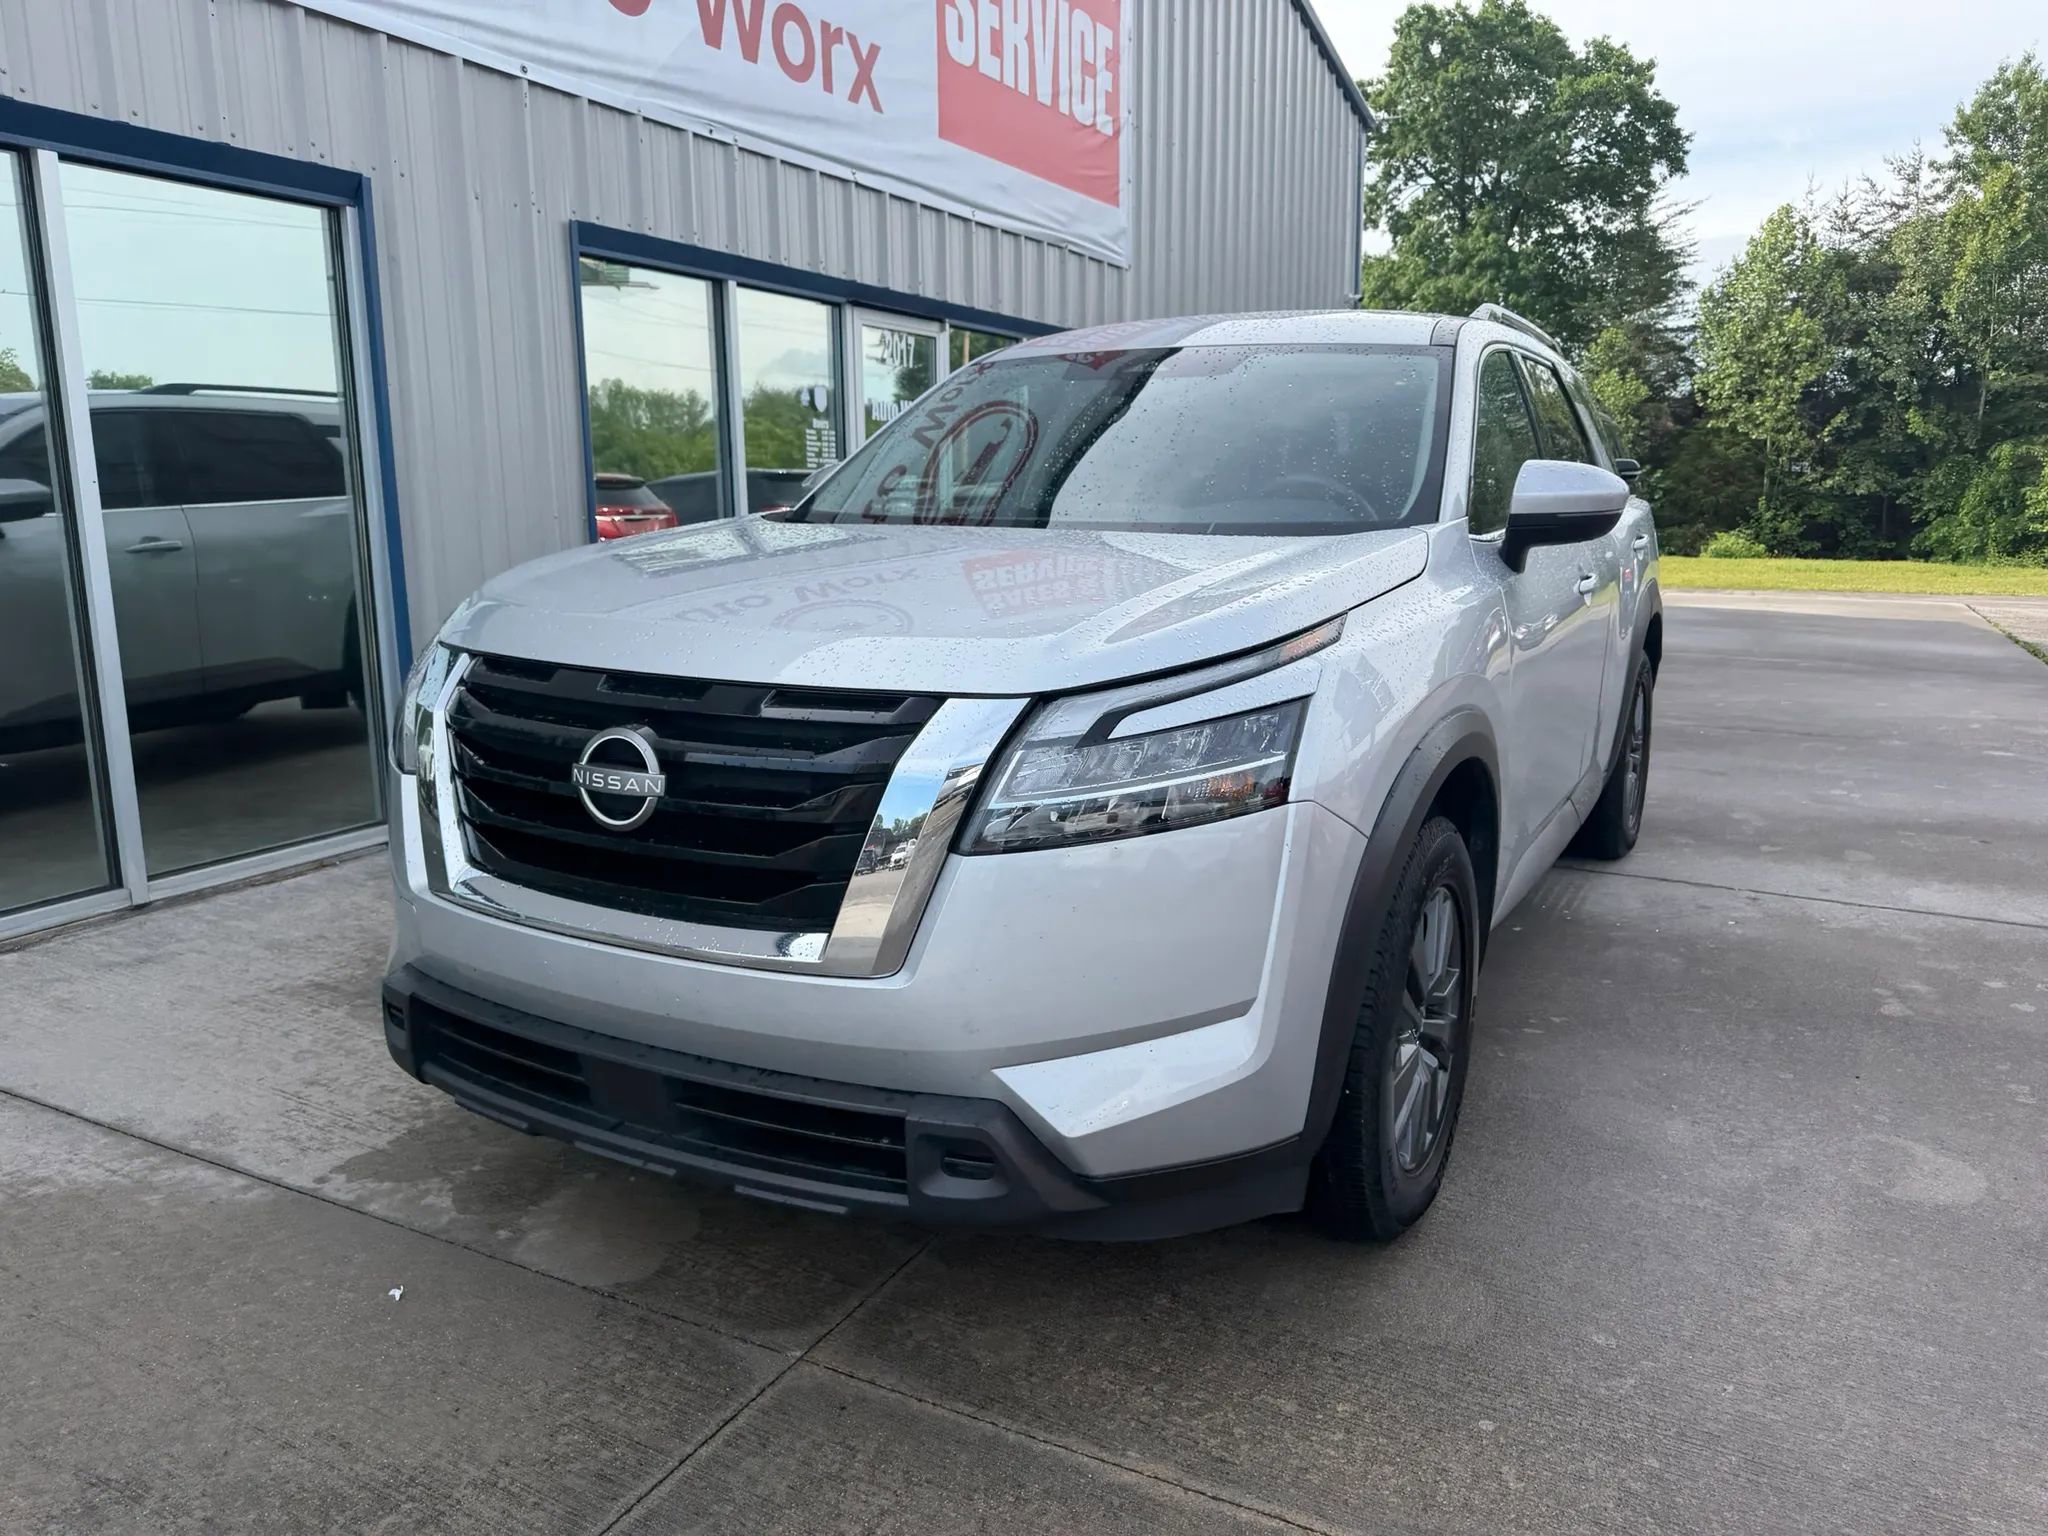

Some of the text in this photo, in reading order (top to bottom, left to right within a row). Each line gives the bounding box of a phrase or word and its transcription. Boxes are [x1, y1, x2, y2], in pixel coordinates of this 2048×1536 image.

[697, 0, 884, 114] Worx
[945, 0, 1114, 137] SERVICE
[882, 329, 916, 369] 2017
[573, 768, 661, 793] NISSAN
